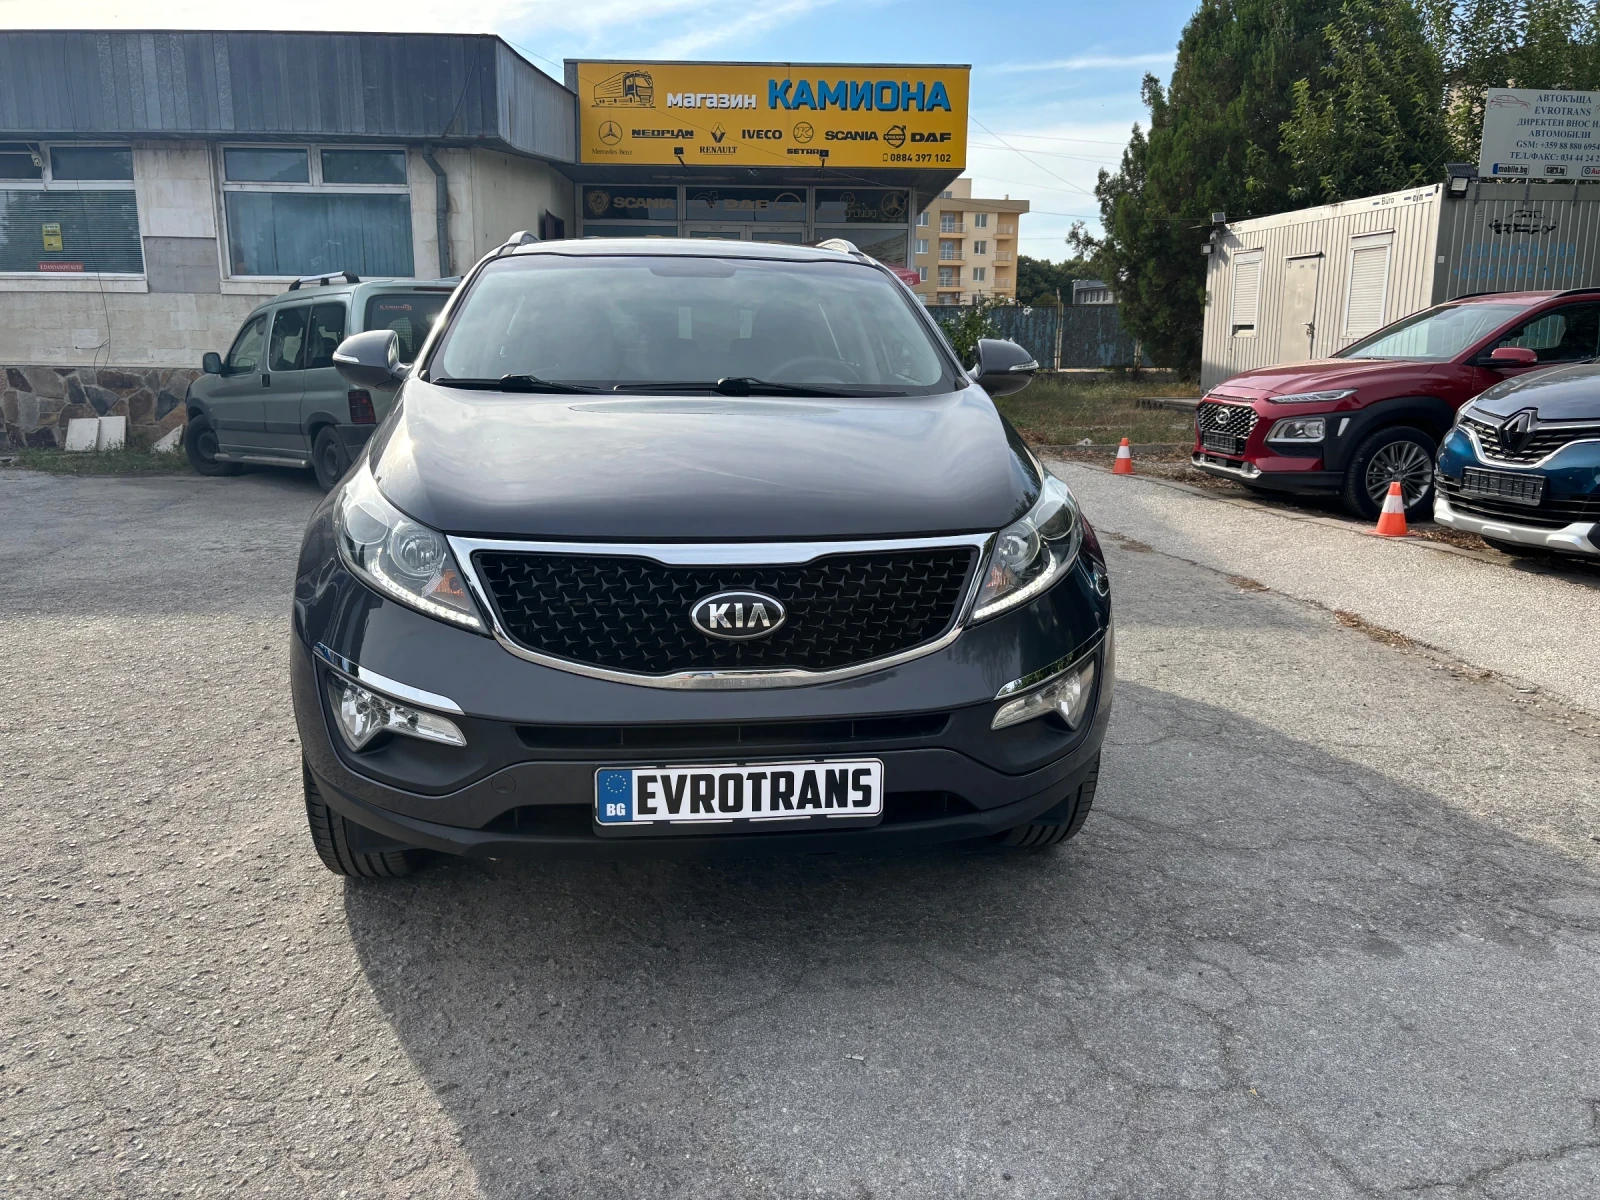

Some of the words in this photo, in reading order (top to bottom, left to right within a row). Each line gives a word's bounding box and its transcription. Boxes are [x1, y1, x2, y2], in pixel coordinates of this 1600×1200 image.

[667, 92, 757, 109] магазин
[768, 79, 952, 112] КАМИОНА
[1536, 94, 1592, 104] АВТОКЪЩА
[1534, 106, 1592, 116] EVROTRANS
[1516, 118, 1564, 127] ДИРЕКТЕН
[1566, 119, 1591, 128] ВНОС
[1592, 120, 1600, 128] Н
[632, 129, 694, 139] NEOPLAN
[742, 129, 783, 140] IVECO
[825, 131, 879, 141] SCANIA
[911, 132, 952, 143] DAF
[1528, 129, 1591, 139] АВТОМОБИЛИ
[699, 146, 738, 154] RENAULT
[1516, 140, 1538, 149] GSM:
[1540, 141, 1558, 150] +359
[1559, 142, 1568, 150] 88
[1569, 142, 1582, 151] 880
[591, 148, 633, 156] Mercedes-Benz
[890, 153, 913, 162] 0884
[915, 153, 932, 162] 397
[935, 154, 952, 162] 102
[1560, 153, 1574, 161] 034
[1574, 154, 1584, 162] 44
[1498, 163, 1528, 174] mobile.bg
[613, 197, 675, 209] SCANIA
[708, 603, 771, 628] KIA
[606, 803, 626, 816] BG
[637, 768, 872, 816] EVROTRANS
